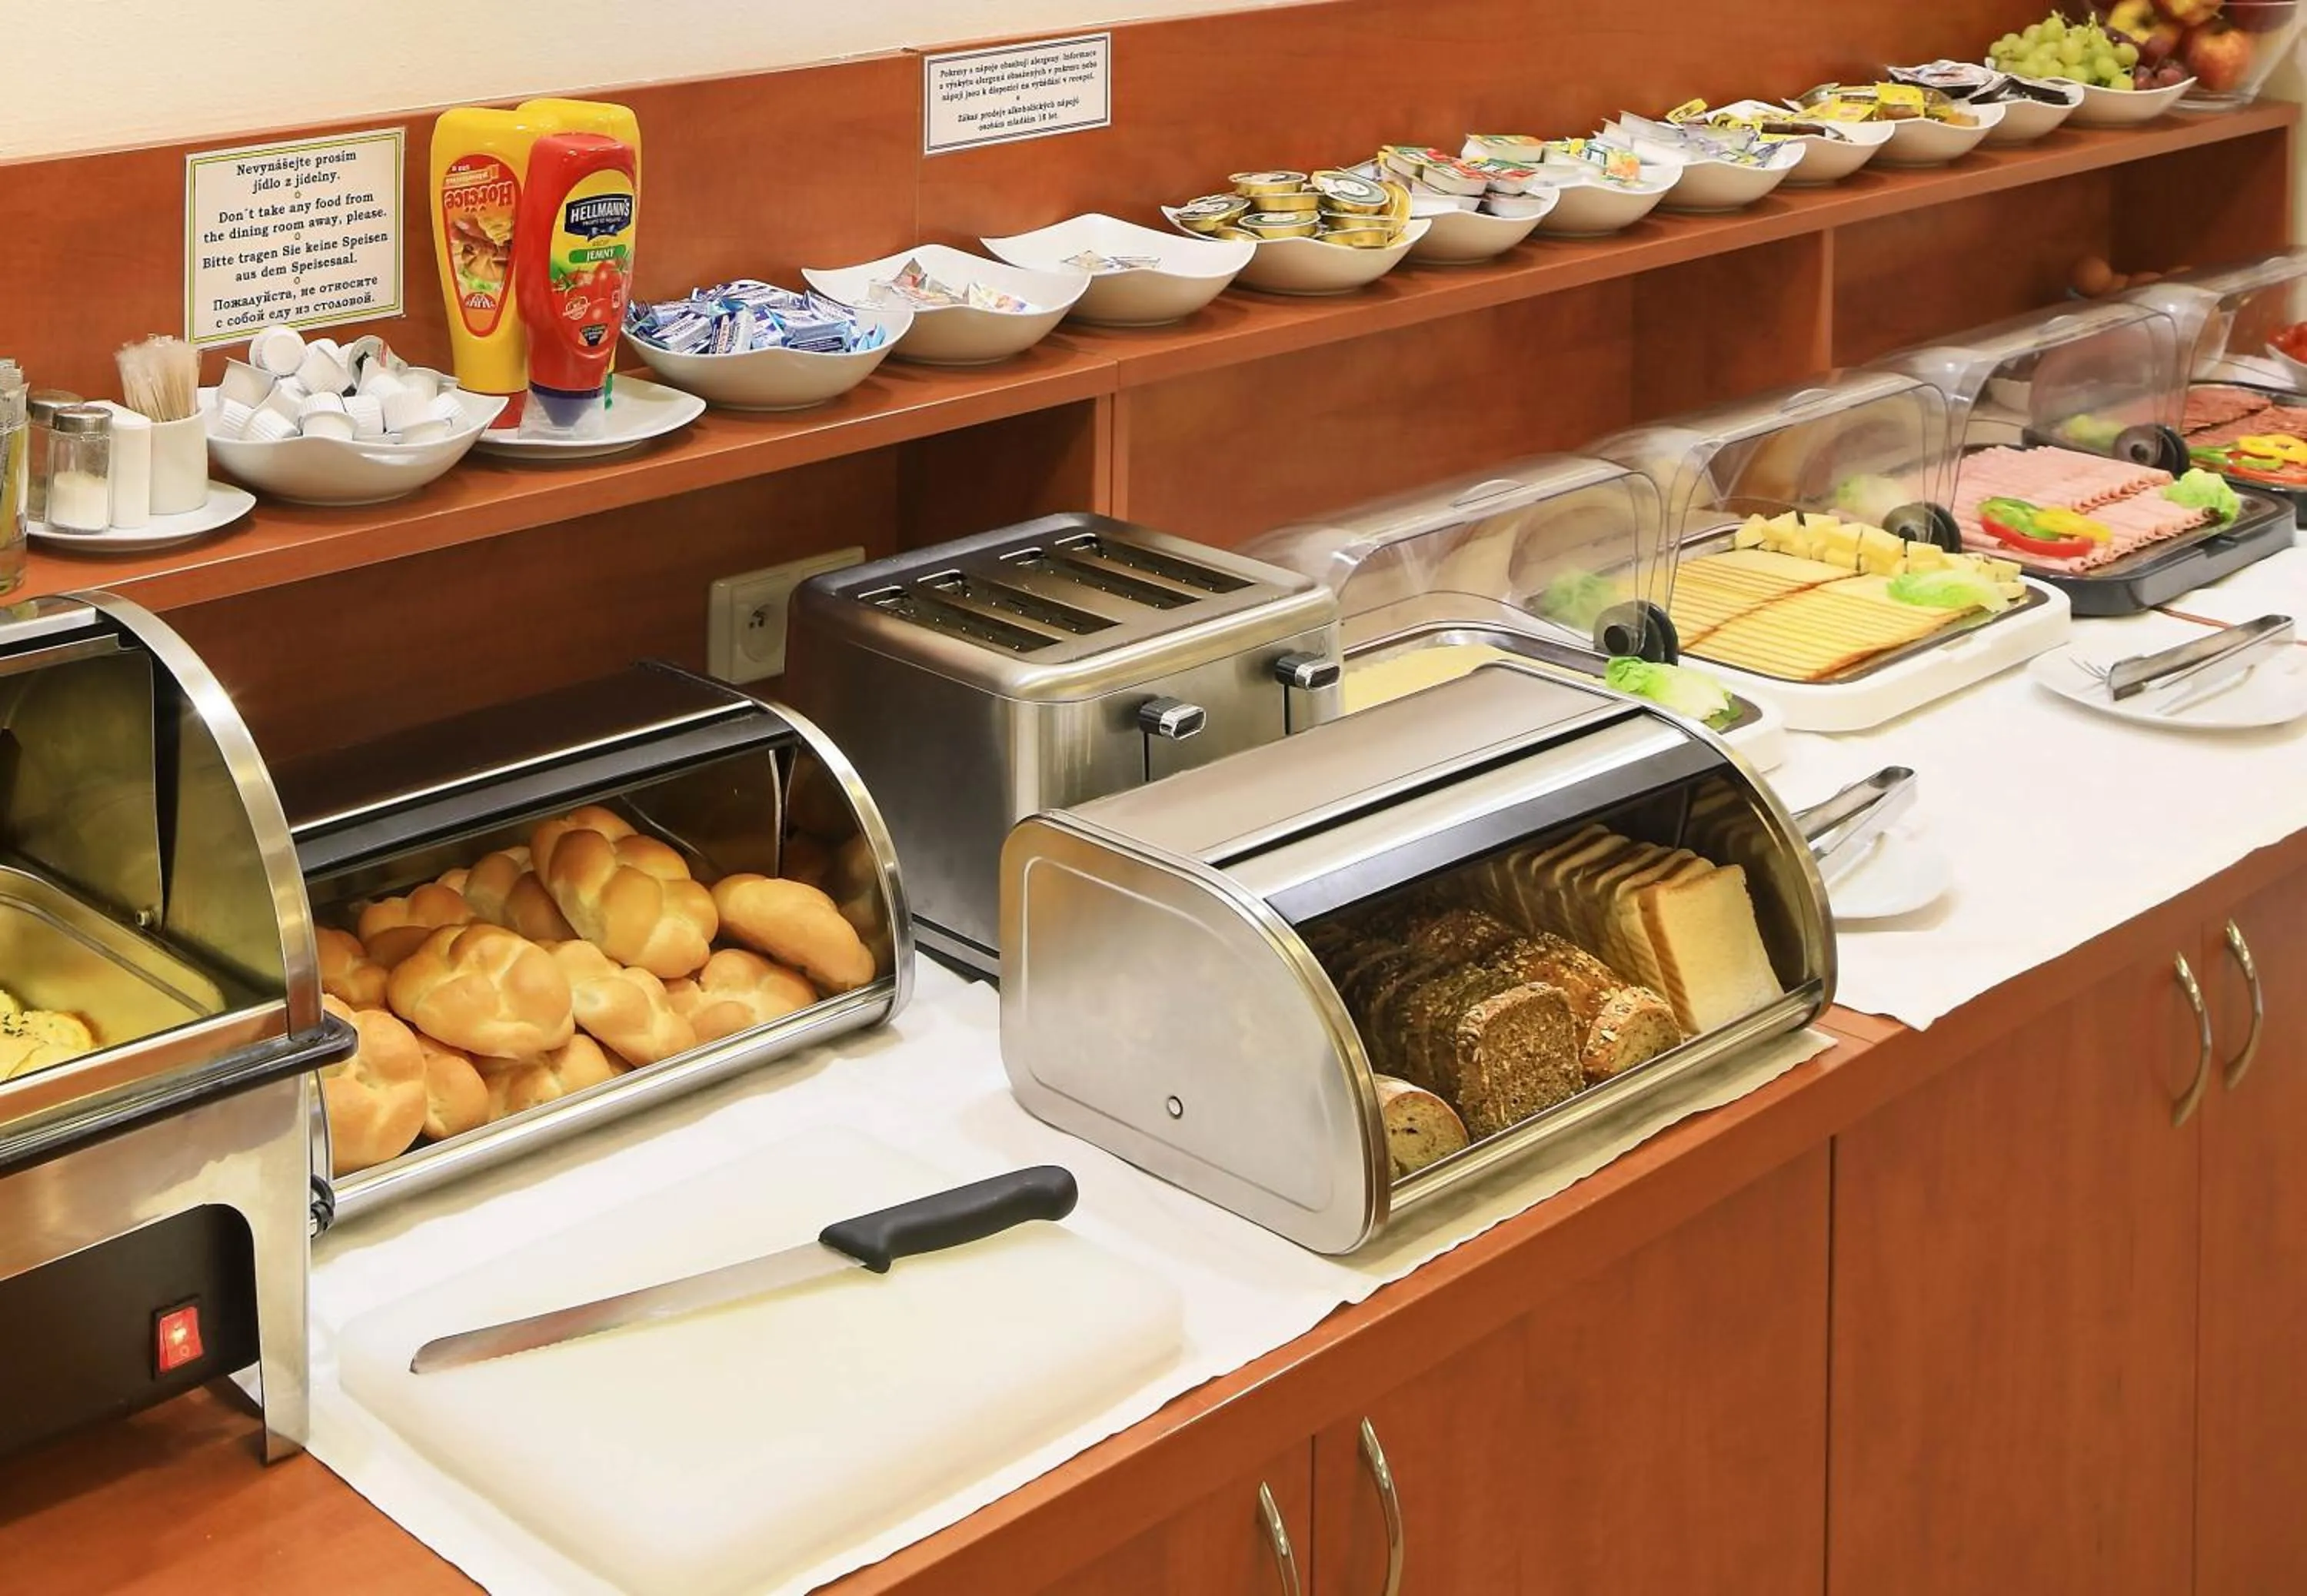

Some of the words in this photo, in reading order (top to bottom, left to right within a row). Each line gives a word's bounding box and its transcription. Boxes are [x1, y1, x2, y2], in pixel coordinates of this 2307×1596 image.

[982, 87, 987, 95] k
[237, 158, 311, 176] Nevynášejte
[315, 151, 356, 167] prosím
[252, 178, 281, 194] jídlo
[285, 178, 291, 186] z
[295, 171, 341, 188] jídelny.
[258, 203, 285, 218] take
[289, 201, 311, 214] any
[315, 195, 341, 209] food
[345, 192, 374, 205] from
[204, 231, 225, 244] the
[228, 222, 269, 240] dining
[273, 219, 305, 233] room
[308, 214, 342, 229] away,
[346, 208, 387, 225] please.
[202, 254, 234, 269] Bitte
[238, 247, 278, 264] tragen
[282, 244, 301, 256] Sie
[305, 238, 338, 253] keine
[342, 231, 388, 248] Speisen
[235, 271, 256, 282] aus
[261, 264, 287, 278] dem
[291, 252, 358, 274] Speisesaal.
[213, 288, 297, 311] Пожалуйста,
[301, 284, 316, 298] не
[319, 276, 378, 294] относите
[216, 318, 222, 328] с
[227, 308, 265, 327] собой
[269, 307, 291, 321] еду
[295, 304, 309, 315] из
[313, 291, 375, 313] столовой.
